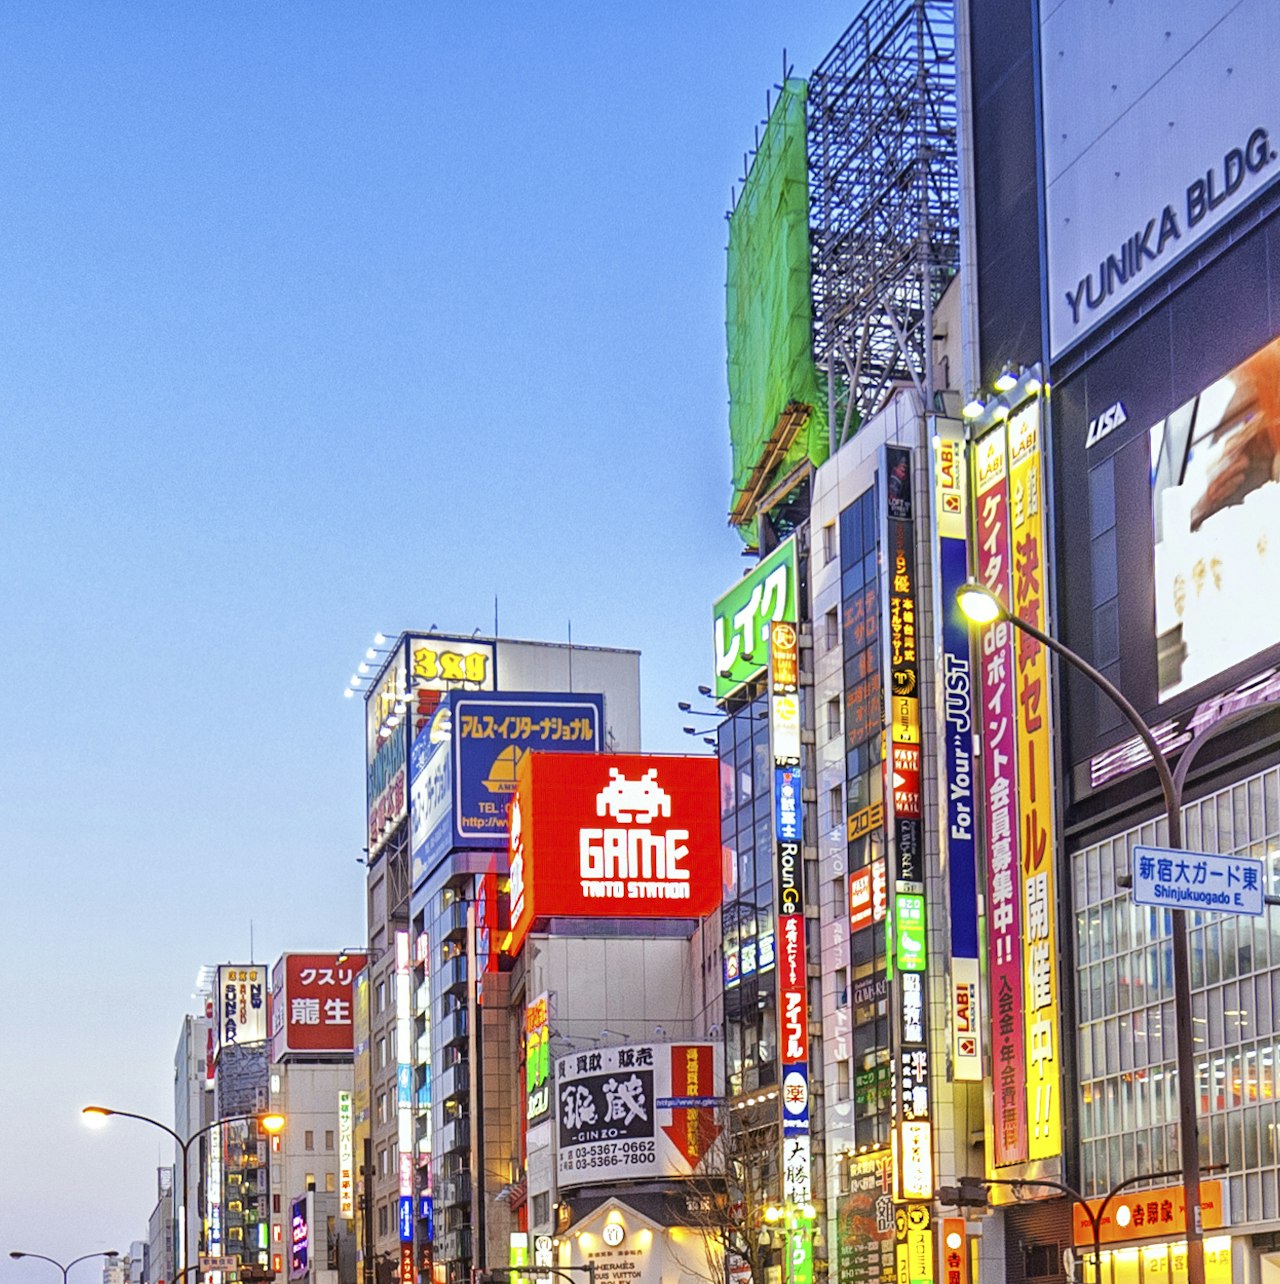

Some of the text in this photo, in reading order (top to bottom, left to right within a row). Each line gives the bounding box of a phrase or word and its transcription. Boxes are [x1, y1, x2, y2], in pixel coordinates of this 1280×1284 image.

[1066, 127, 1277, 323] YUNIKA BLDG.
[1085, 402, 1128, 450] LISA
[1012, 429, 1037, 460] LABI
[941, 443, 954, 490] LABI
[979, 453, 1003, 483] LABI
[714, 563, 789, 674] レイク
[461, 715, 593, 740] アムス・インターナショナル
[946, 654, 972, 841] For Your JUST
[579, 828, 689, 880] GAME
[781, 843, 800, 914] RounGe
[1139, 855, 1259, 892] 新宿大ガード東
[580, 880, 690, 899] TAITO STATION
[1154, 884, 1245, 907] Shinjukuogado E.
[299, 968, 353, 986] クスリ
[251, 984, 262, 1010] NEW
[956, 983, 970, 1033] LABI
[225, 984, 237, 1042] SUNPARK
[290, 999, 352, 1026] 龍生
[785, 992, 804, 1059] アイフル
[575, 1140, 656, 1160] 03-5367-0662
[575, 1152, 657, 1171] 03-5366-7800
[1131, 1199, 1174, 1228] 吉野家
[592, 1271, 612, 1280] OUIS
[1149, 1258, 1168, 1273] 2F
